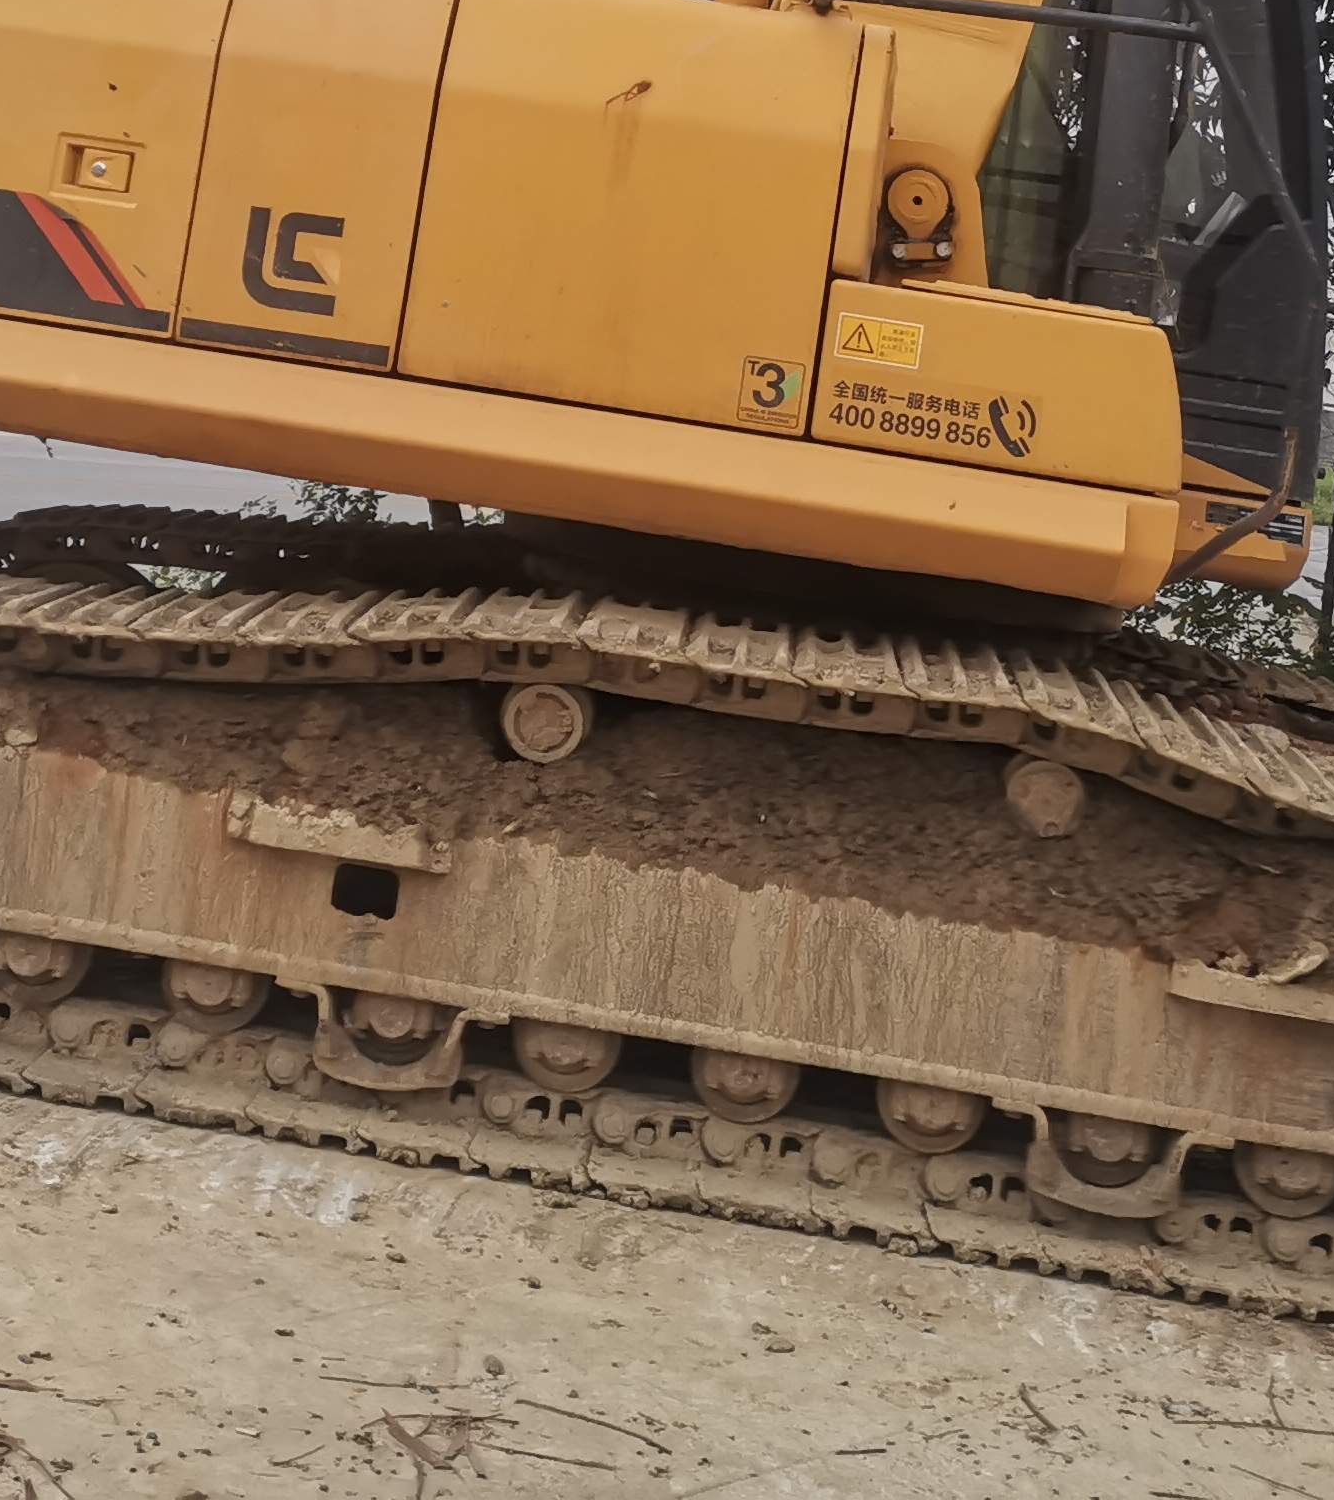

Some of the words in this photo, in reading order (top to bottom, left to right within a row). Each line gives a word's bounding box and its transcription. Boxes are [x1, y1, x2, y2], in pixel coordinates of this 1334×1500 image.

[832, 379, 981, 420] 全国统一服务电话
[829, 402, 875, 430] 400
[879, 410, 941, 440] 8899
[945, 421, 992, 449] 856
